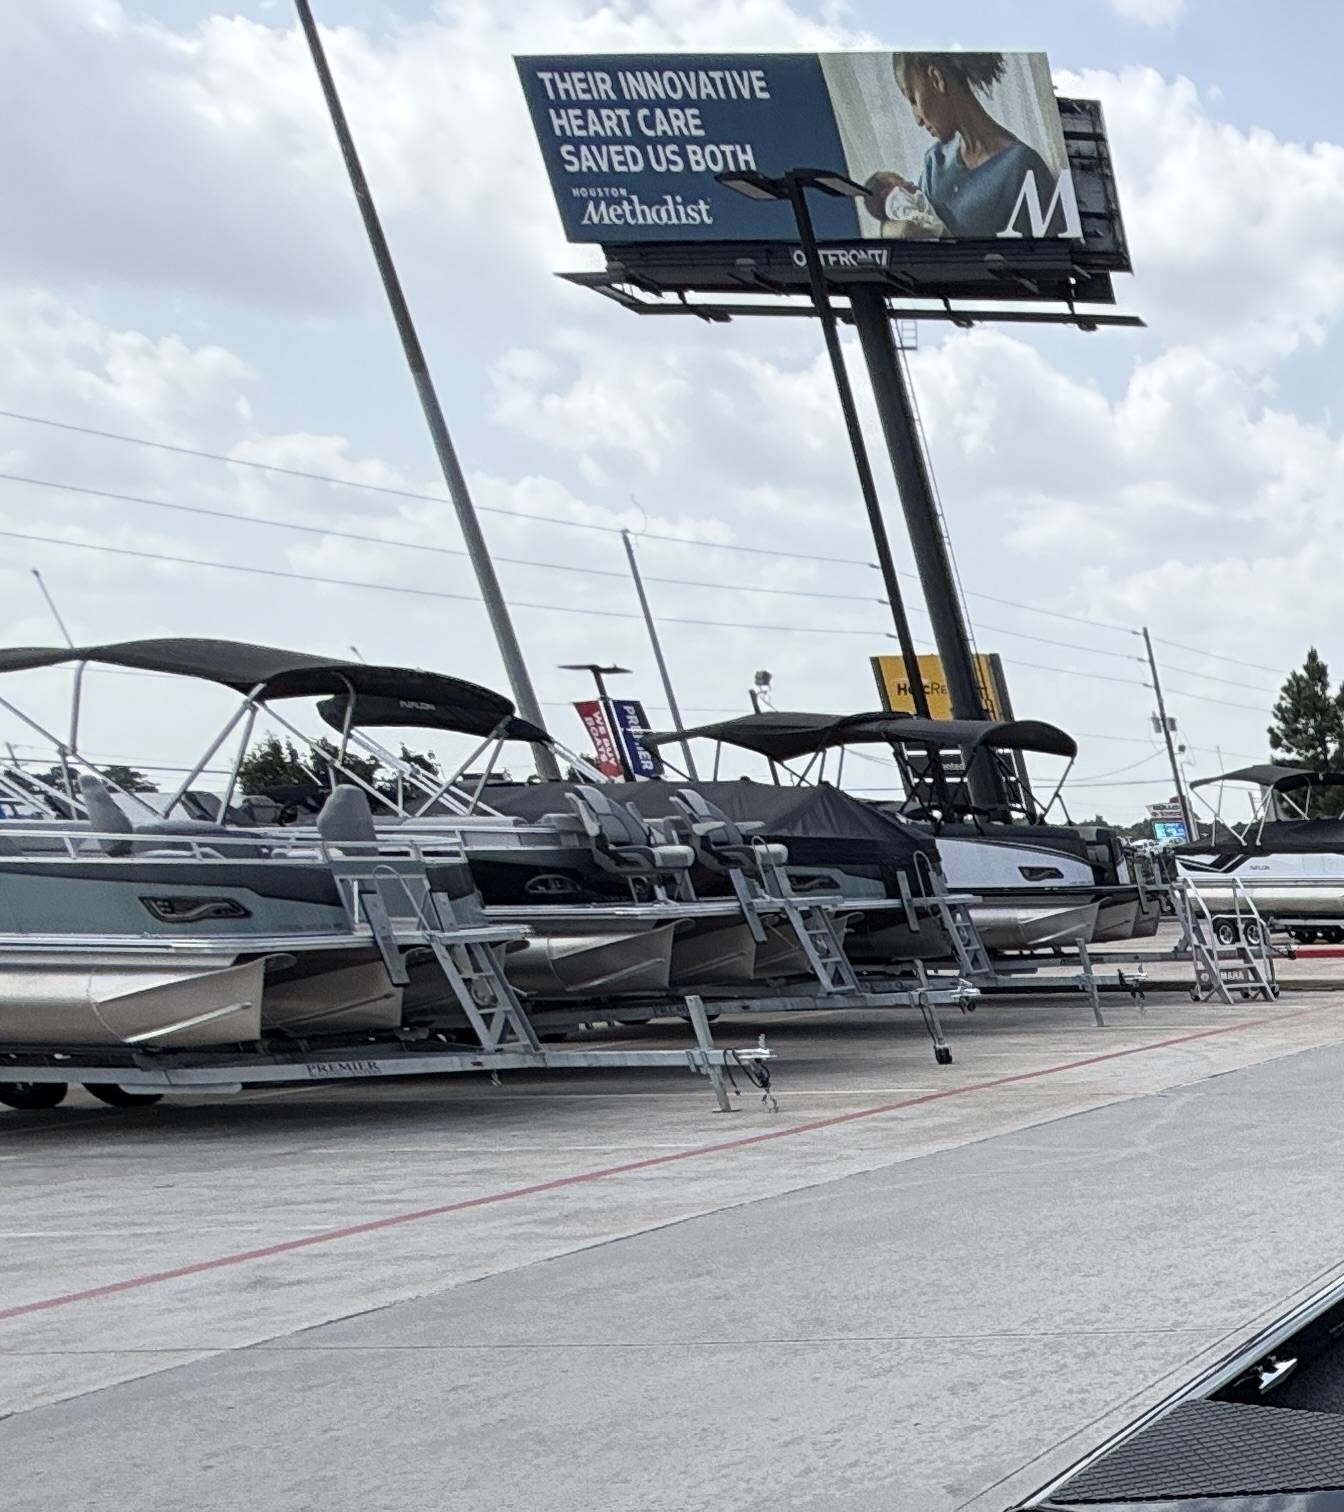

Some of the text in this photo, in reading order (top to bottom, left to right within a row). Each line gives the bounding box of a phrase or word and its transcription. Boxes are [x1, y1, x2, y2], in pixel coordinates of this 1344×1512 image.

[537, 69, 770, 101] THEIR INNOVATIVE
[550, 107, 705, 138] HEART CARE
[561, 144, 757, 173] SAVED US BOTH
[572, 187, 628, 198] HOUSTON
[581, 195, 713, 226] Methodist
